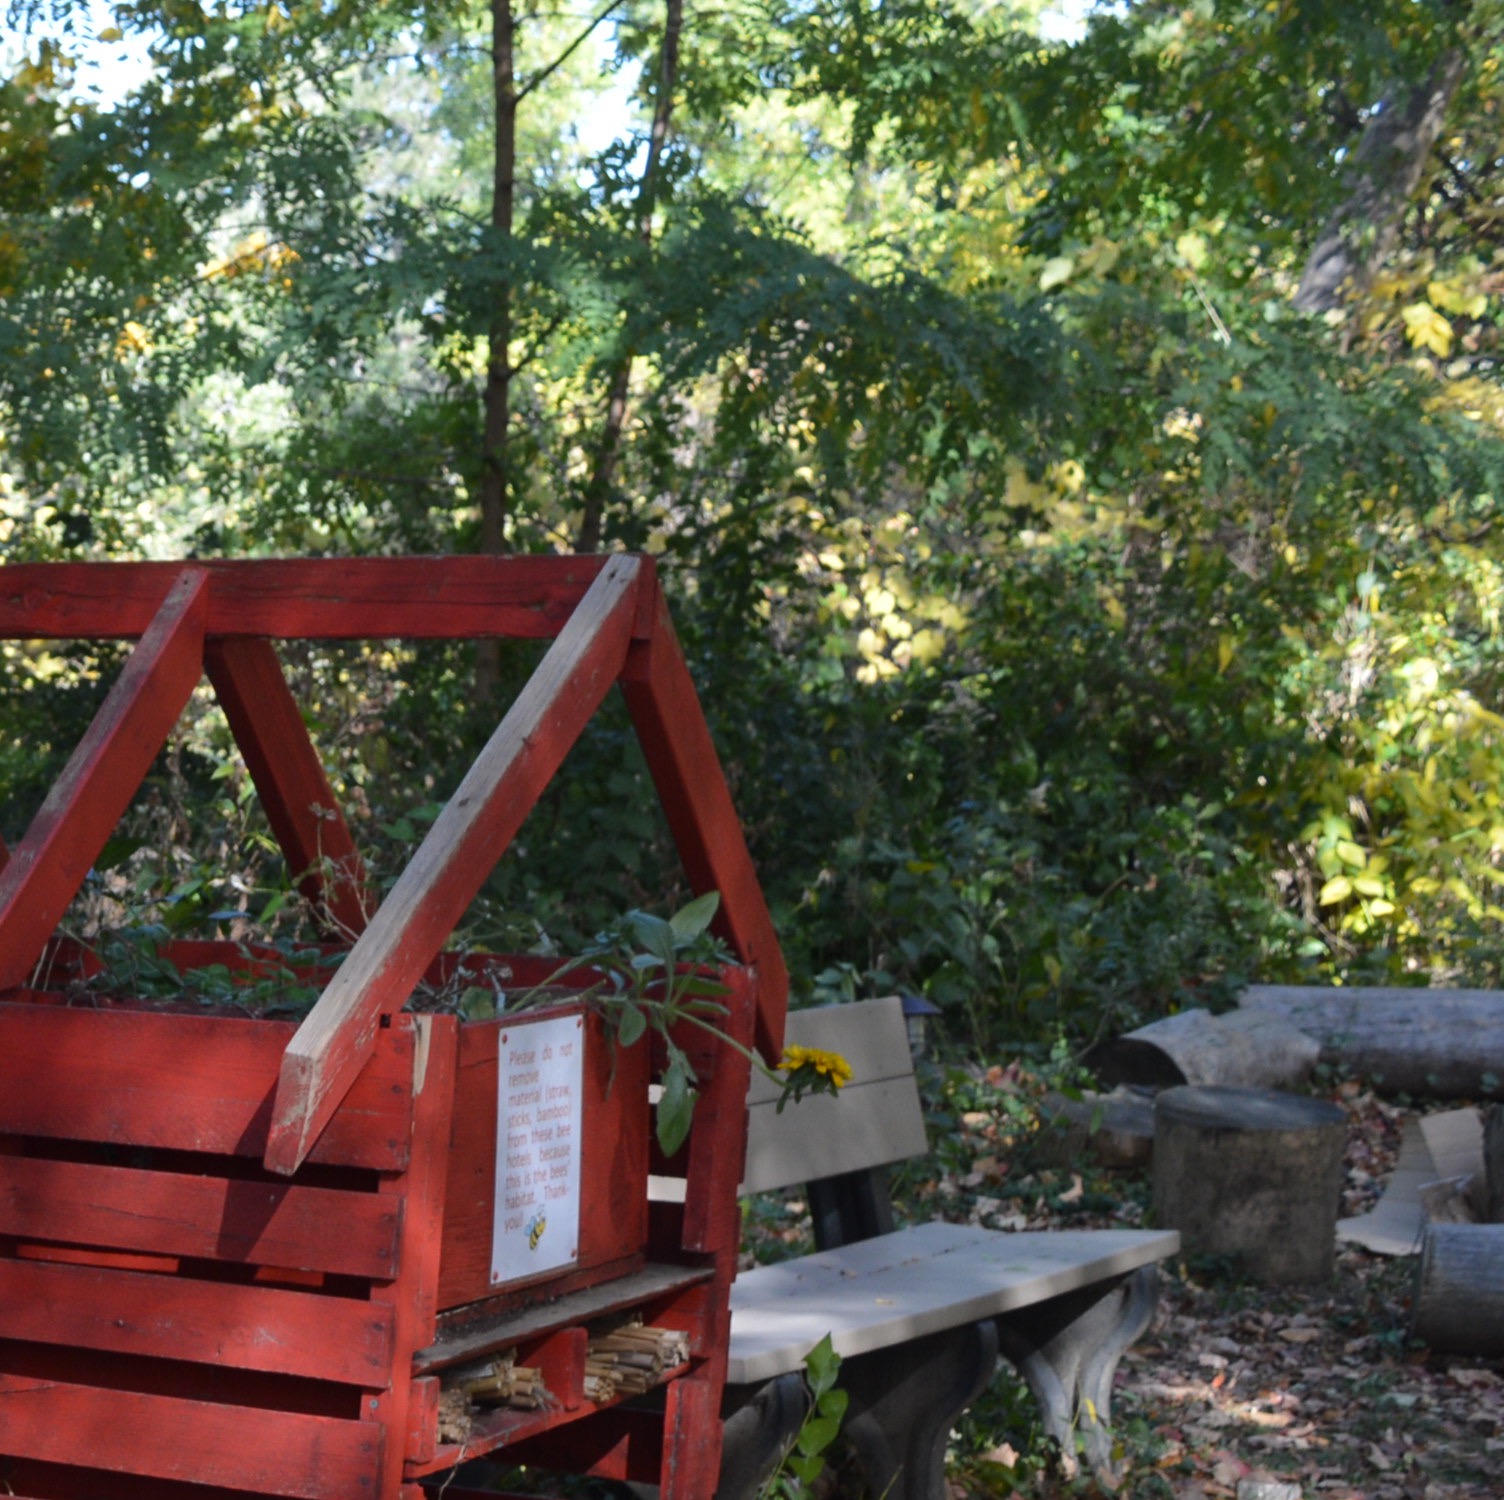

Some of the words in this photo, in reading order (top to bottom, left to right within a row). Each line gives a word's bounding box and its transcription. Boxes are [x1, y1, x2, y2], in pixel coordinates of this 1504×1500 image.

[509, 1050, 536, 1066] Please
[542, 1043, 552, 1060] do
[560, 1043, 572, 1057] not
[509, 1070, 539, 1087] remove
[508, 1085, 542, 1106] material
[507, 1131, 527, 1148] from
[531, 1126, 552, 1143] these
[557, 1121, 571, 1137] bee
[507, 1148, 532, 1168] hotels
[540, 1144, 570, 1161] because
[506, 1173, 521, 1189] this
[533, 1167, 546, 1183] the
